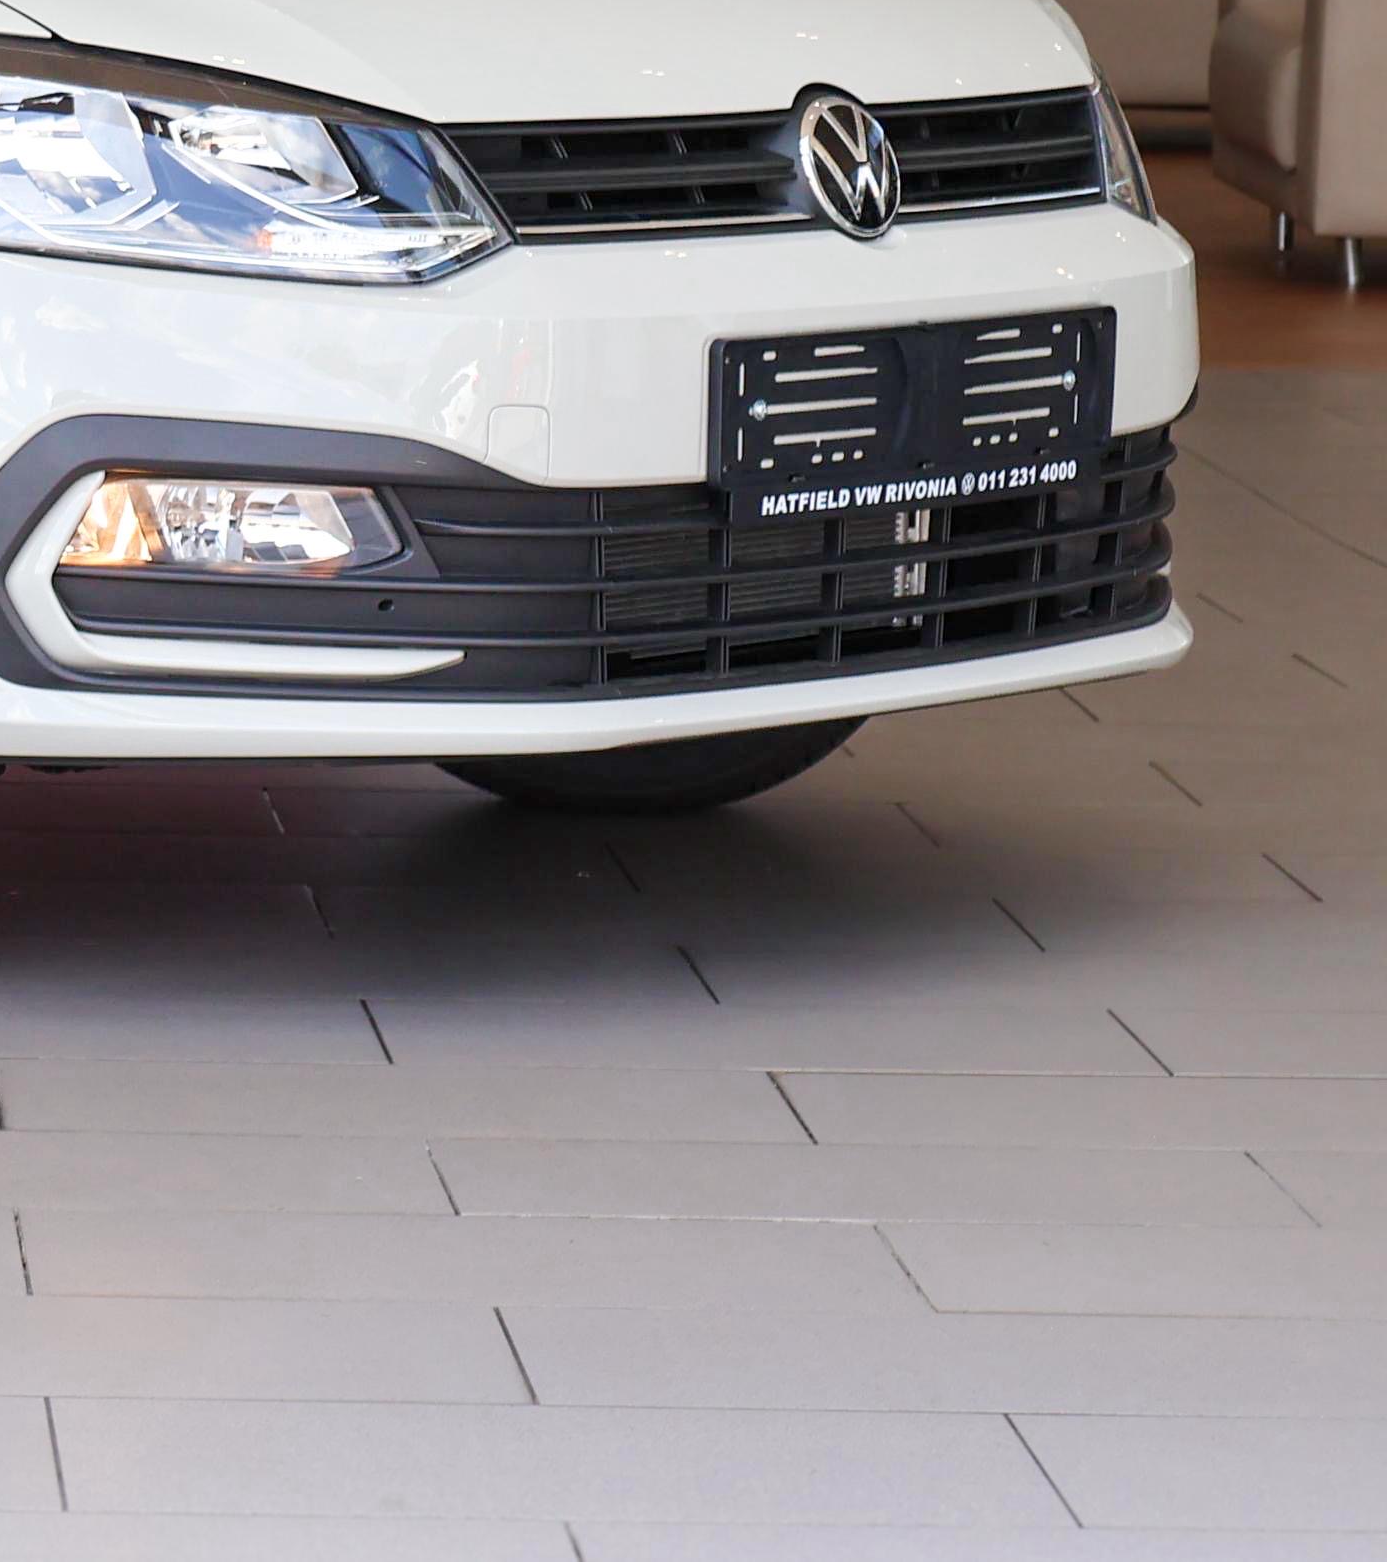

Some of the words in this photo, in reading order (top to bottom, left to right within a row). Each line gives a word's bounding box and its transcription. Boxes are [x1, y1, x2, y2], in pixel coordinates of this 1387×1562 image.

[761, 489, 851, 516] HATFIELD
[854, 484, 883, 507] VW
[884, 477, 957, 503] RIVONIA
[978, 469, 1006, 492] 011
[1008, 465, 1036, 488] 231
[1039, 459, 1077, 483] 4000
